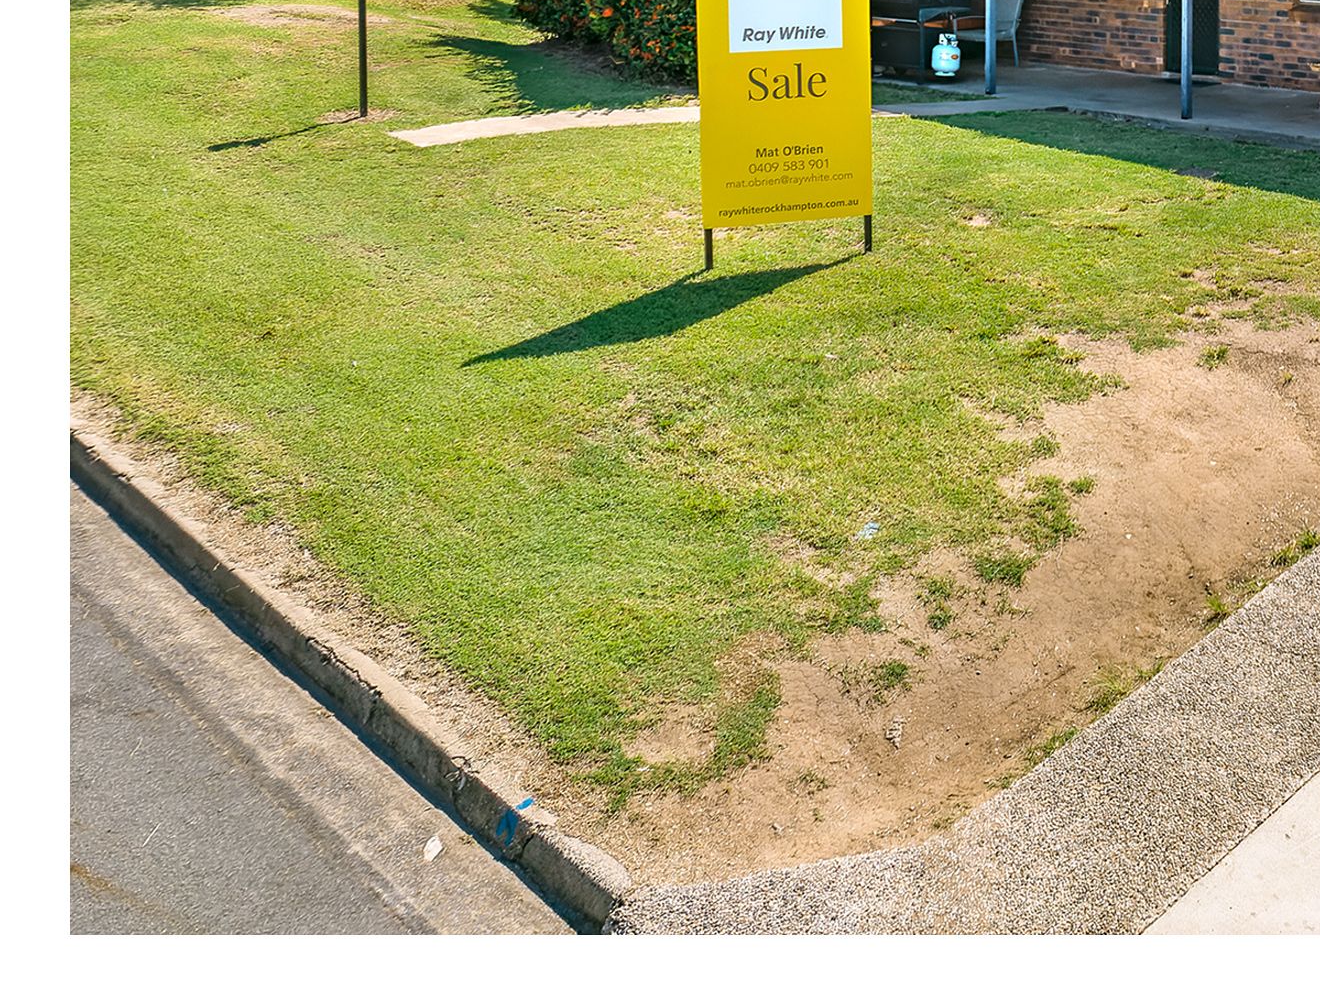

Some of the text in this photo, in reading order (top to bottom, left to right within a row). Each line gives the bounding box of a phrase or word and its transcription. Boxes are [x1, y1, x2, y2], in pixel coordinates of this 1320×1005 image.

[742, 25, 827, 44] Ray White
[748, 62, 828, 102] Sale
[755, 144, 824, 159] Mat O'Brien
[748, 158, 830, 175] 0409 583 901
[725, 171, 854, 189] mat.obrien@raywhite.com
[718, 198, 860, 218] raywhiterockhampton.com.au
